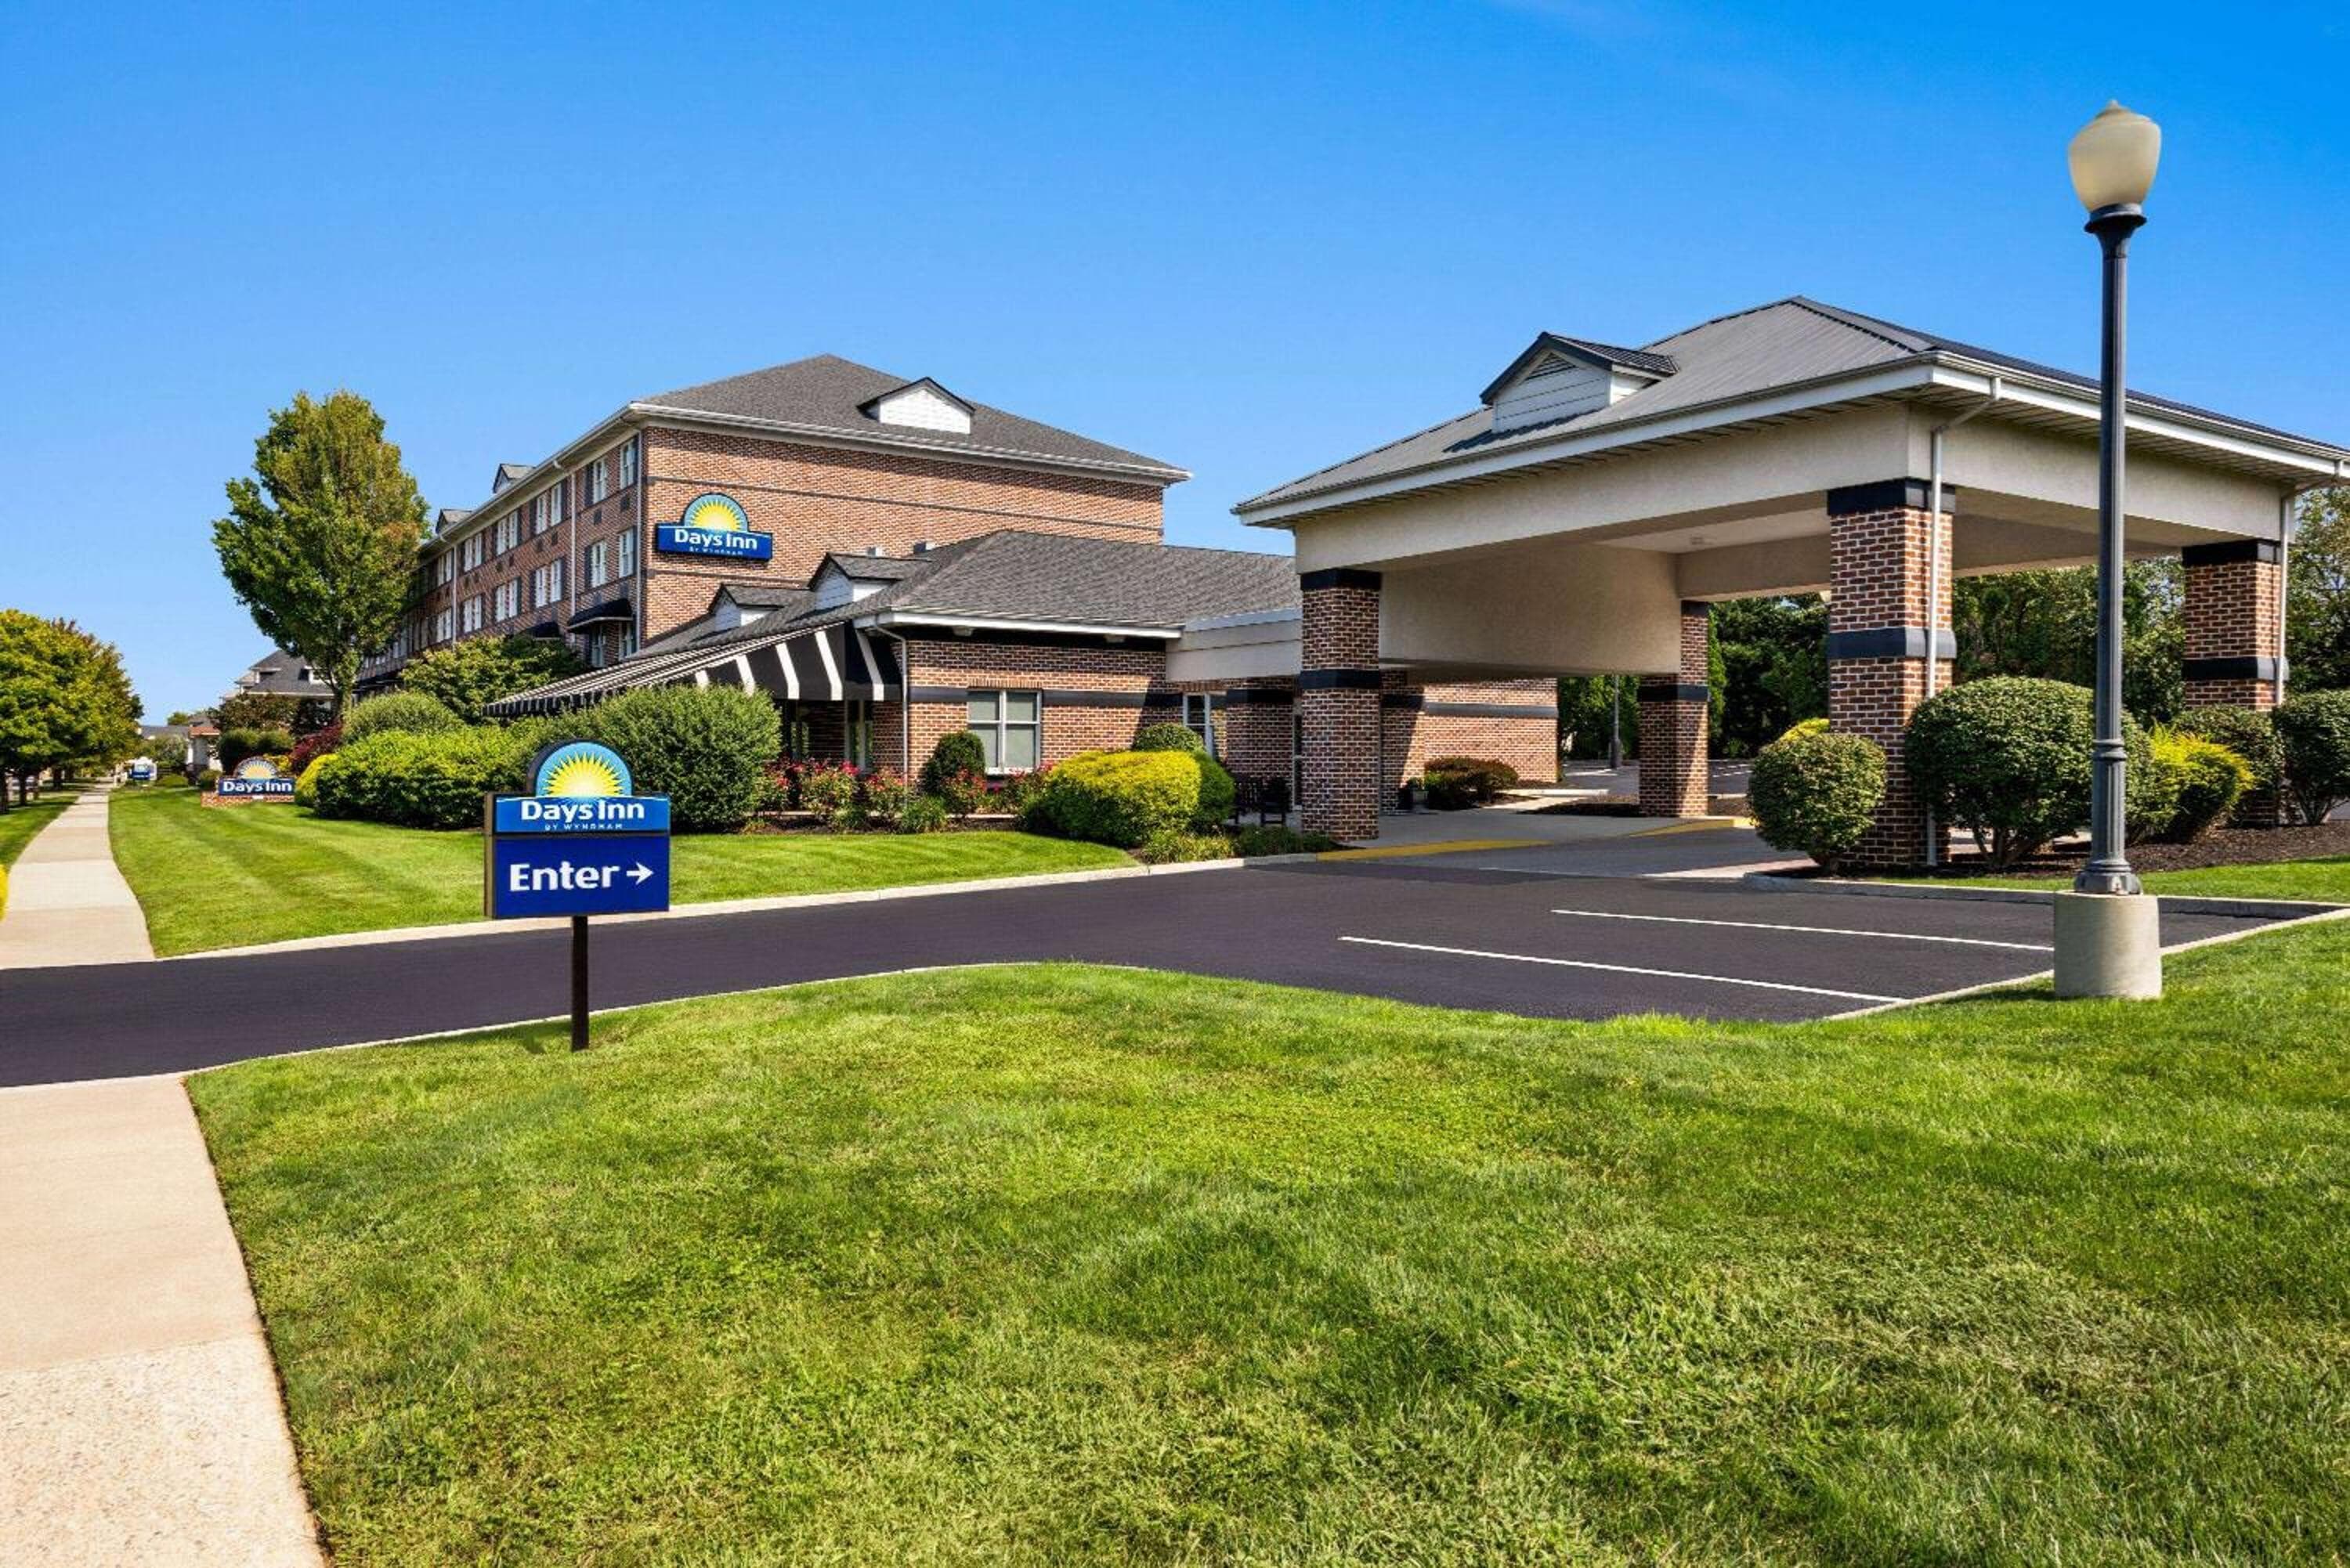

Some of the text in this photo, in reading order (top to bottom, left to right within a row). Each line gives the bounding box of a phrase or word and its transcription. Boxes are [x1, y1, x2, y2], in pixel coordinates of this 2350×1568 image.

[674, 529, 757, 550] Days Inn
[223, 781, 292, 793] Days Inn
[521, 800, 645, 822] Days Inn
[510, 861, 620, 891] Enter
